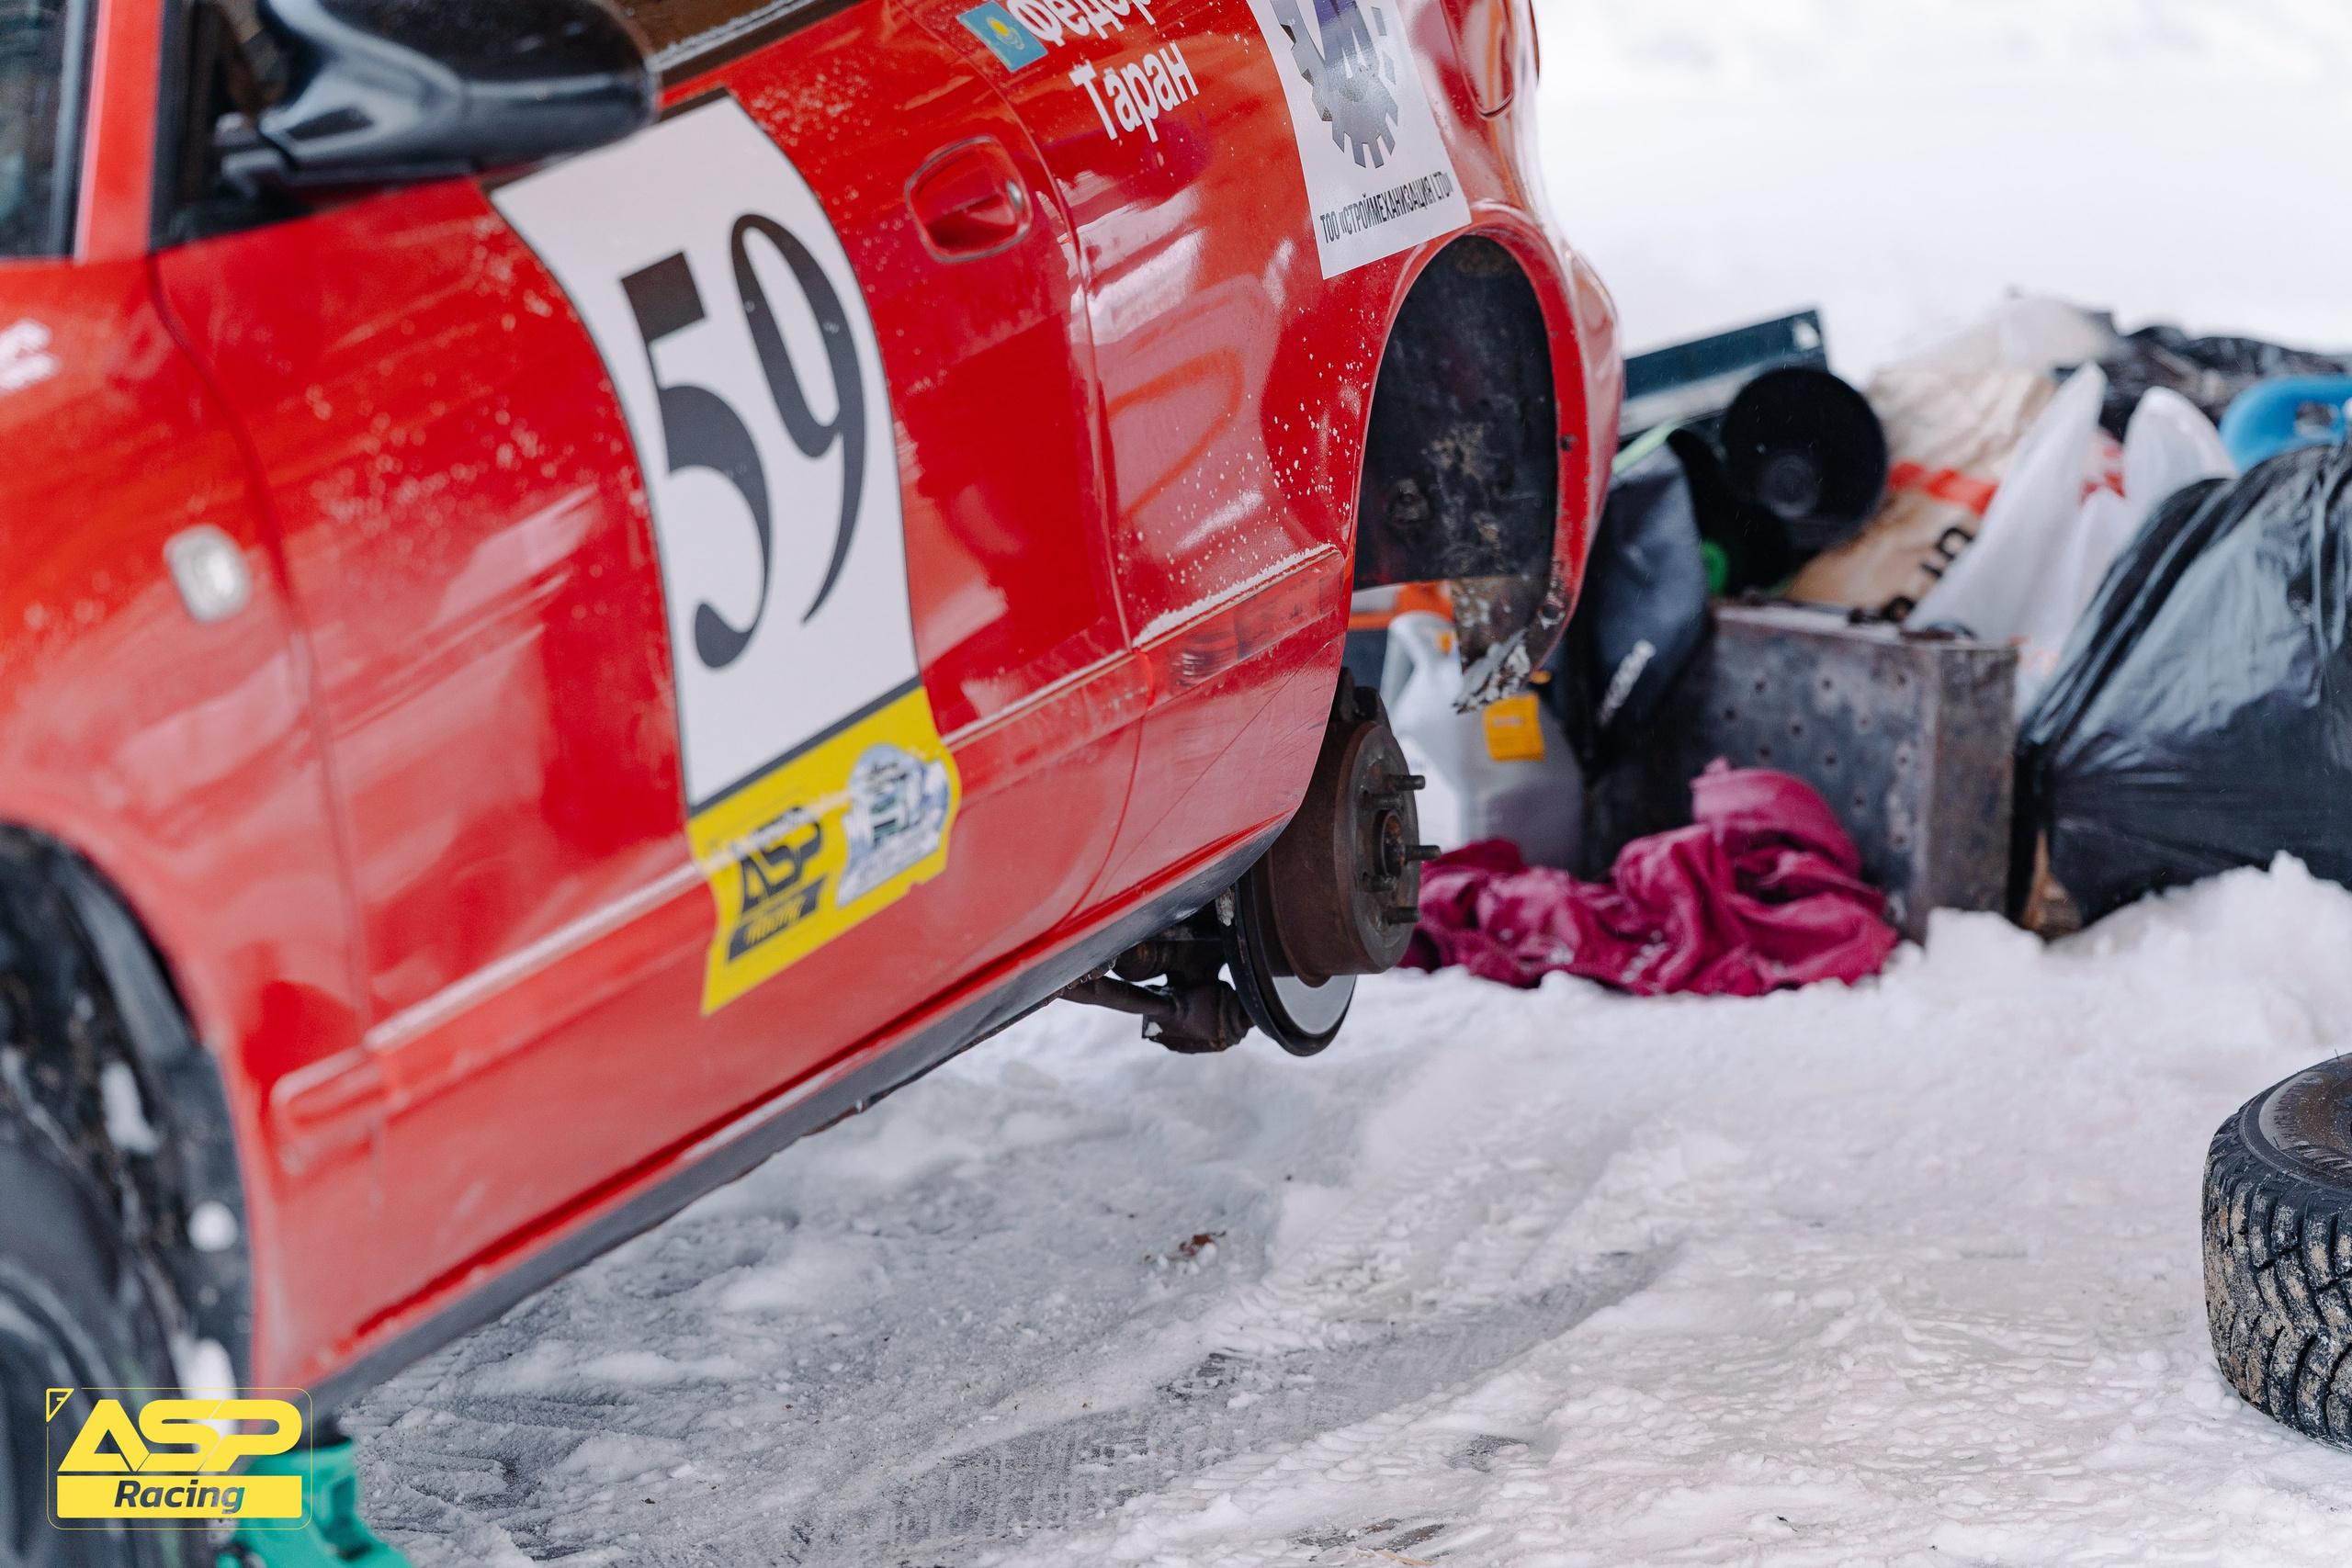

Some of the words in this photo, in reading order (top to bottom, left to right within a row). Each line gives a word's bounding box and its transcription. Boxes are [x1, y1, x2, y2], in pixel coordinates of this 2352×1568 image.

[1006, 0, 1157, 47] Фед
[1069, 42, 1199, 143] Таран
[1319, 210, 1340, 243] ТОО
[620, 213, 866, 670] 59
